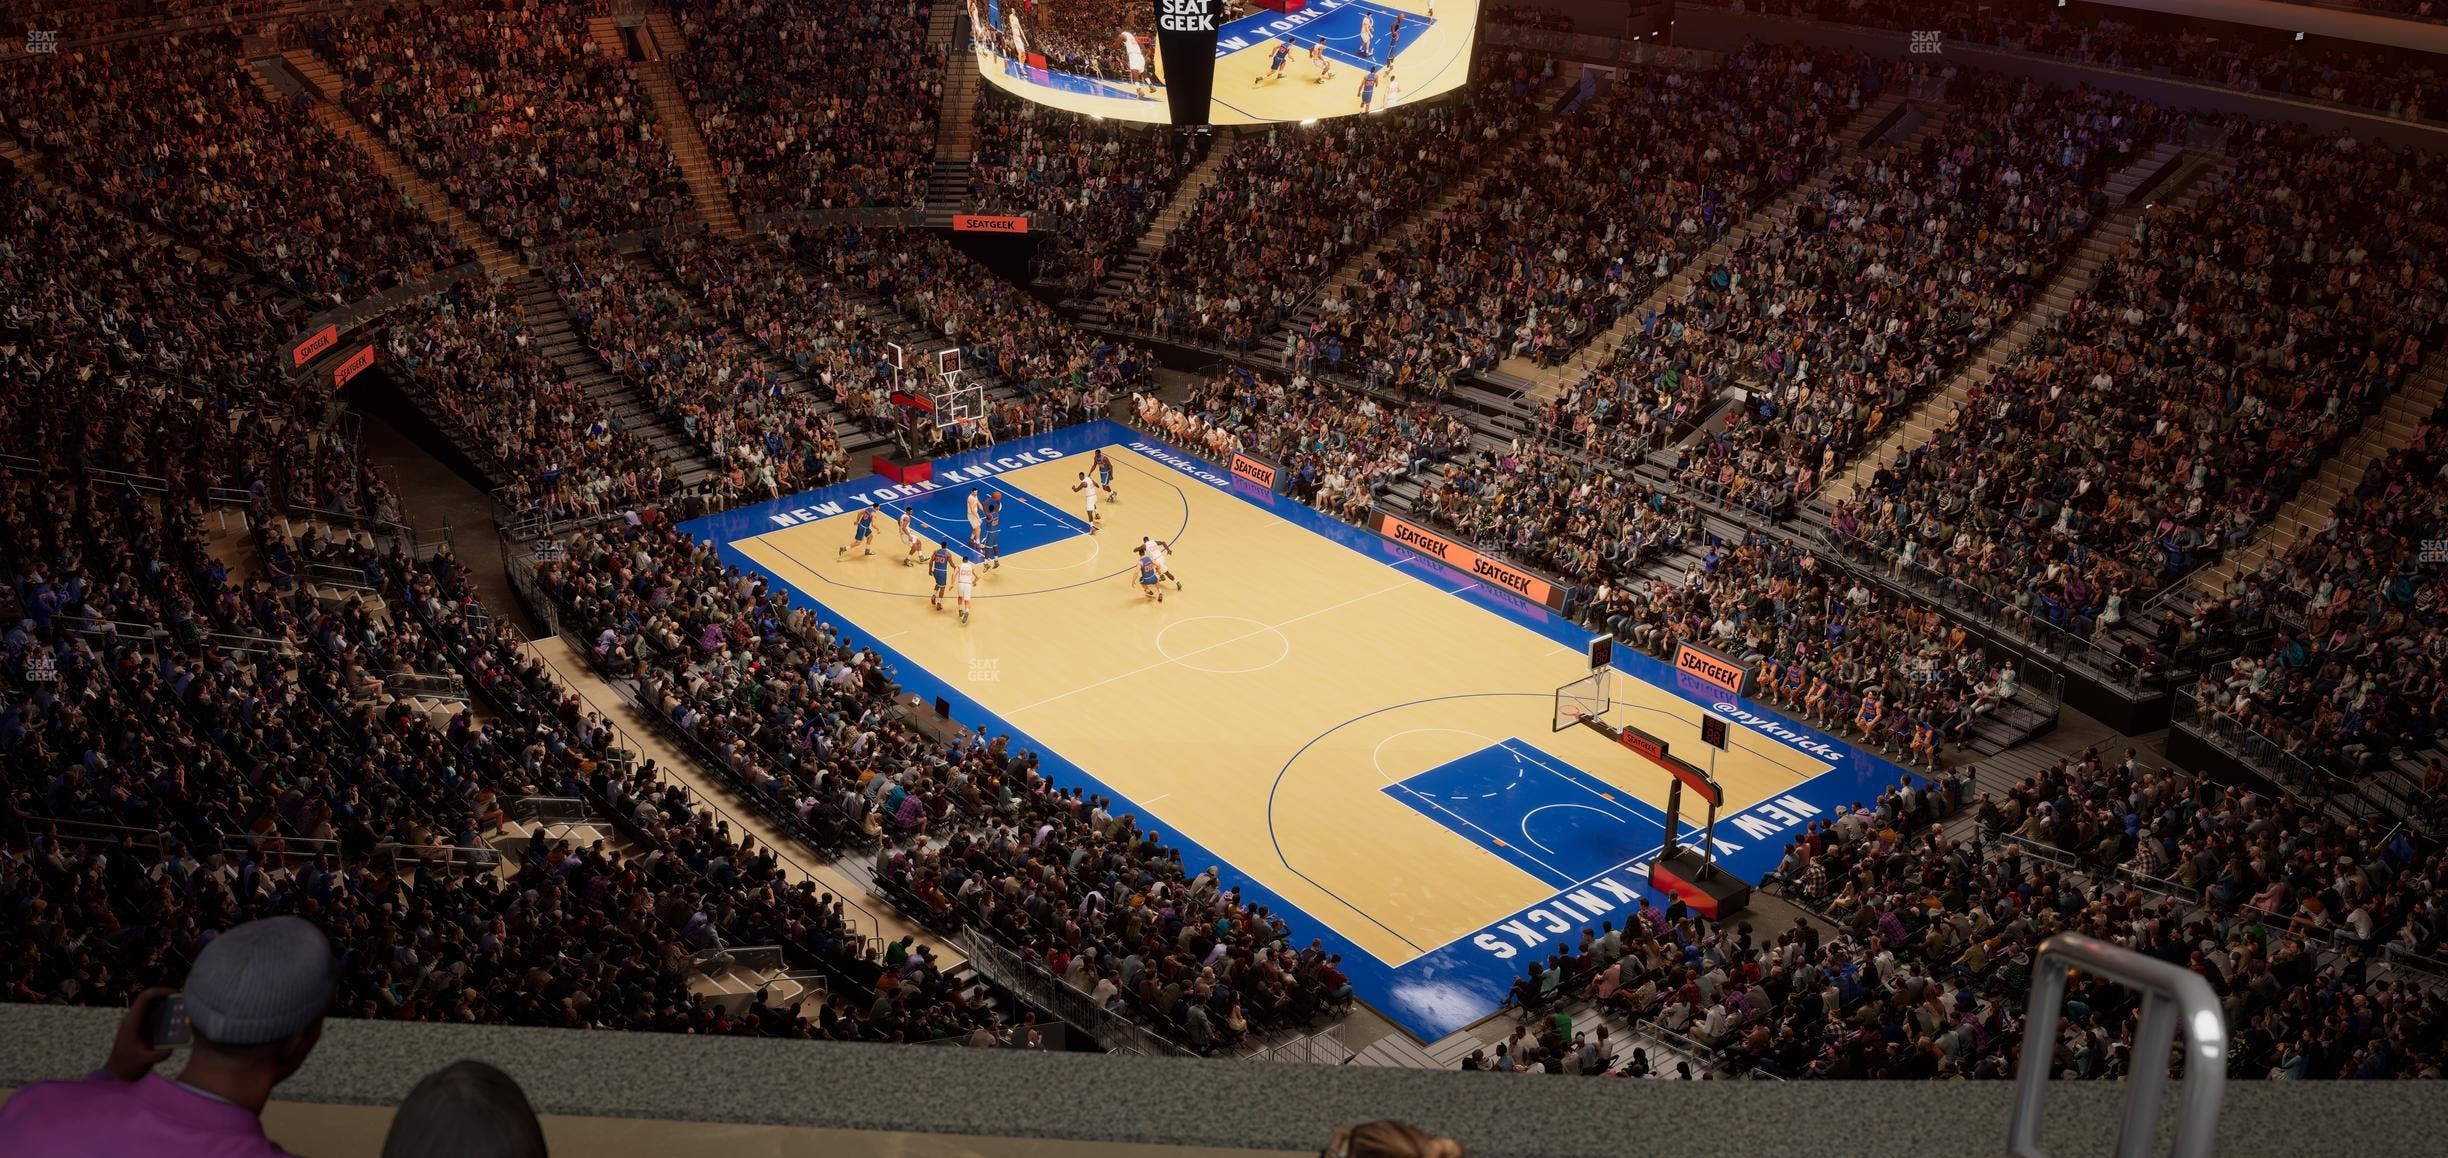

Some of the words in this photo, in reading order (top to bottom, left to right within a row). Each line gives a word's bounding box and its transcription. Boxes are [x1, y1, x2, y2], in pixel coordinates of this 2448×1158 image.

[1160, 14, 1215, 31] GEEK
[1162, 0, 1211, 14] SEAT
[1215, 36, 1250, 57] EW
[966, 219, 1015, 230] SEATGEEK
[300, 333, 329, 360] SEATGEEK
[1128, 441, 1230, 487] nyknicks.com
[1234, 458, 1272, 486] SEATGEEK
[769, 501, 845, 527] NEW
[942, 447, 1064, 483] KNICKS
[1394, 524, 1449, 560] SEATGEEK
[1473, 558, 1532, 595] SEATGEEK
[1681, 652, 1738, 688] SEATGEEK
[1626, 734, 1657, 753] SEATGEEK
[1712, 702, 1844, 761] @nyknicks
[1730, 794, 1823, 841] NEW
[1473, 876, 1641, 959] KNICKS
